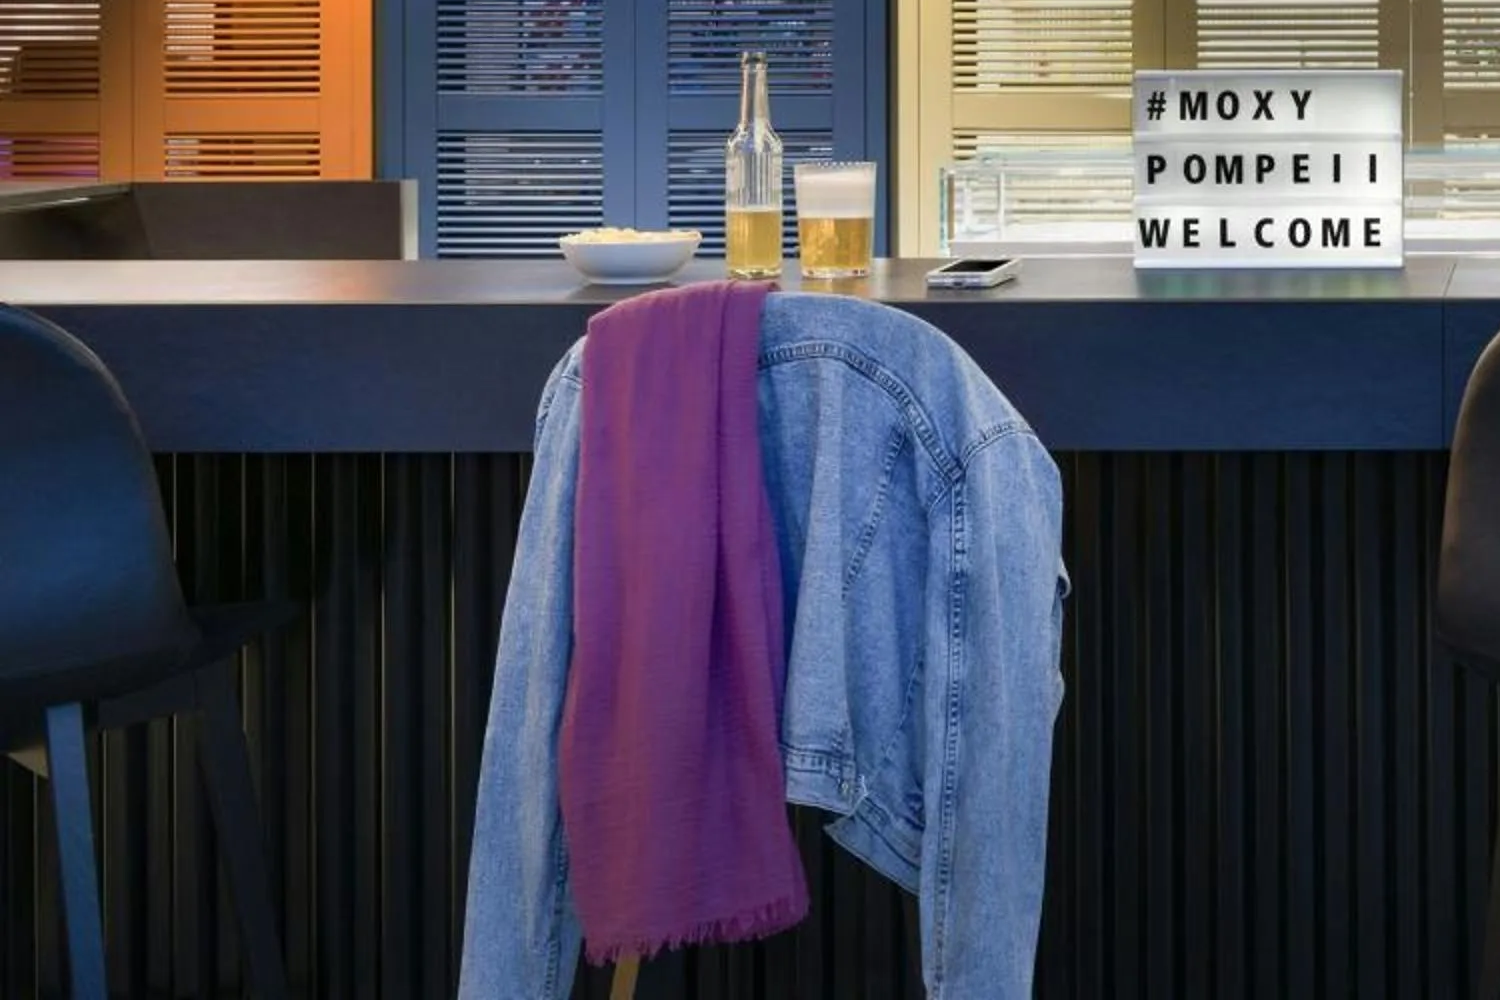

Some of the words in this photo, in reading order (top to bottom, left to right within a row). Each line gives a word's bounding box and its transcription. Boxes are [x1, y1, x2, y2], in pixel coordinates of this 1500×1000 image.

[1147, 90, 1312, 120] #MOXY
[1147, 154, 1377, 184] POMPEII
[1139, 218, 1381, 248] WELCOME
